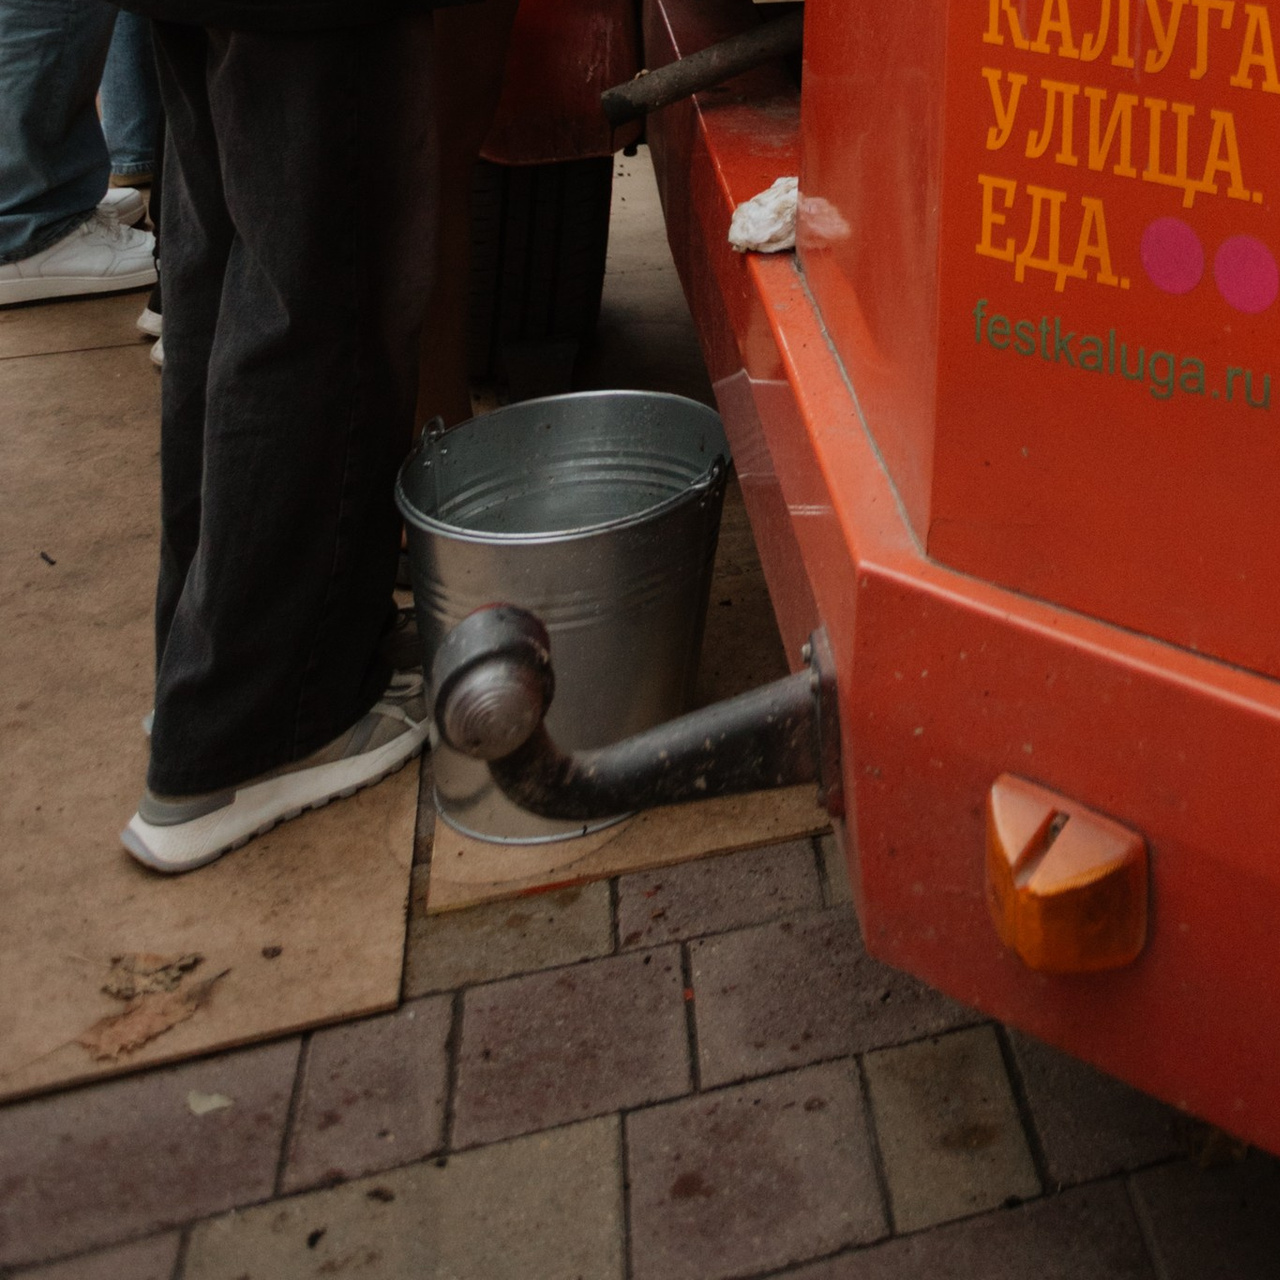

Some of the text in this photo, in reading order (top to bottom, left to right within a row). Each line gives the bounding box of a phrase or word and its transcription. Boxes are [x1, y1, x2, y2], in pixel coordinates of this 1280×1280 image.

[981, 66, 1264, 209] УЛИЦА.
[975, 173, 1130, 292] ЕДА.
[972, 299, 1272, 410] festkaluga.ru
